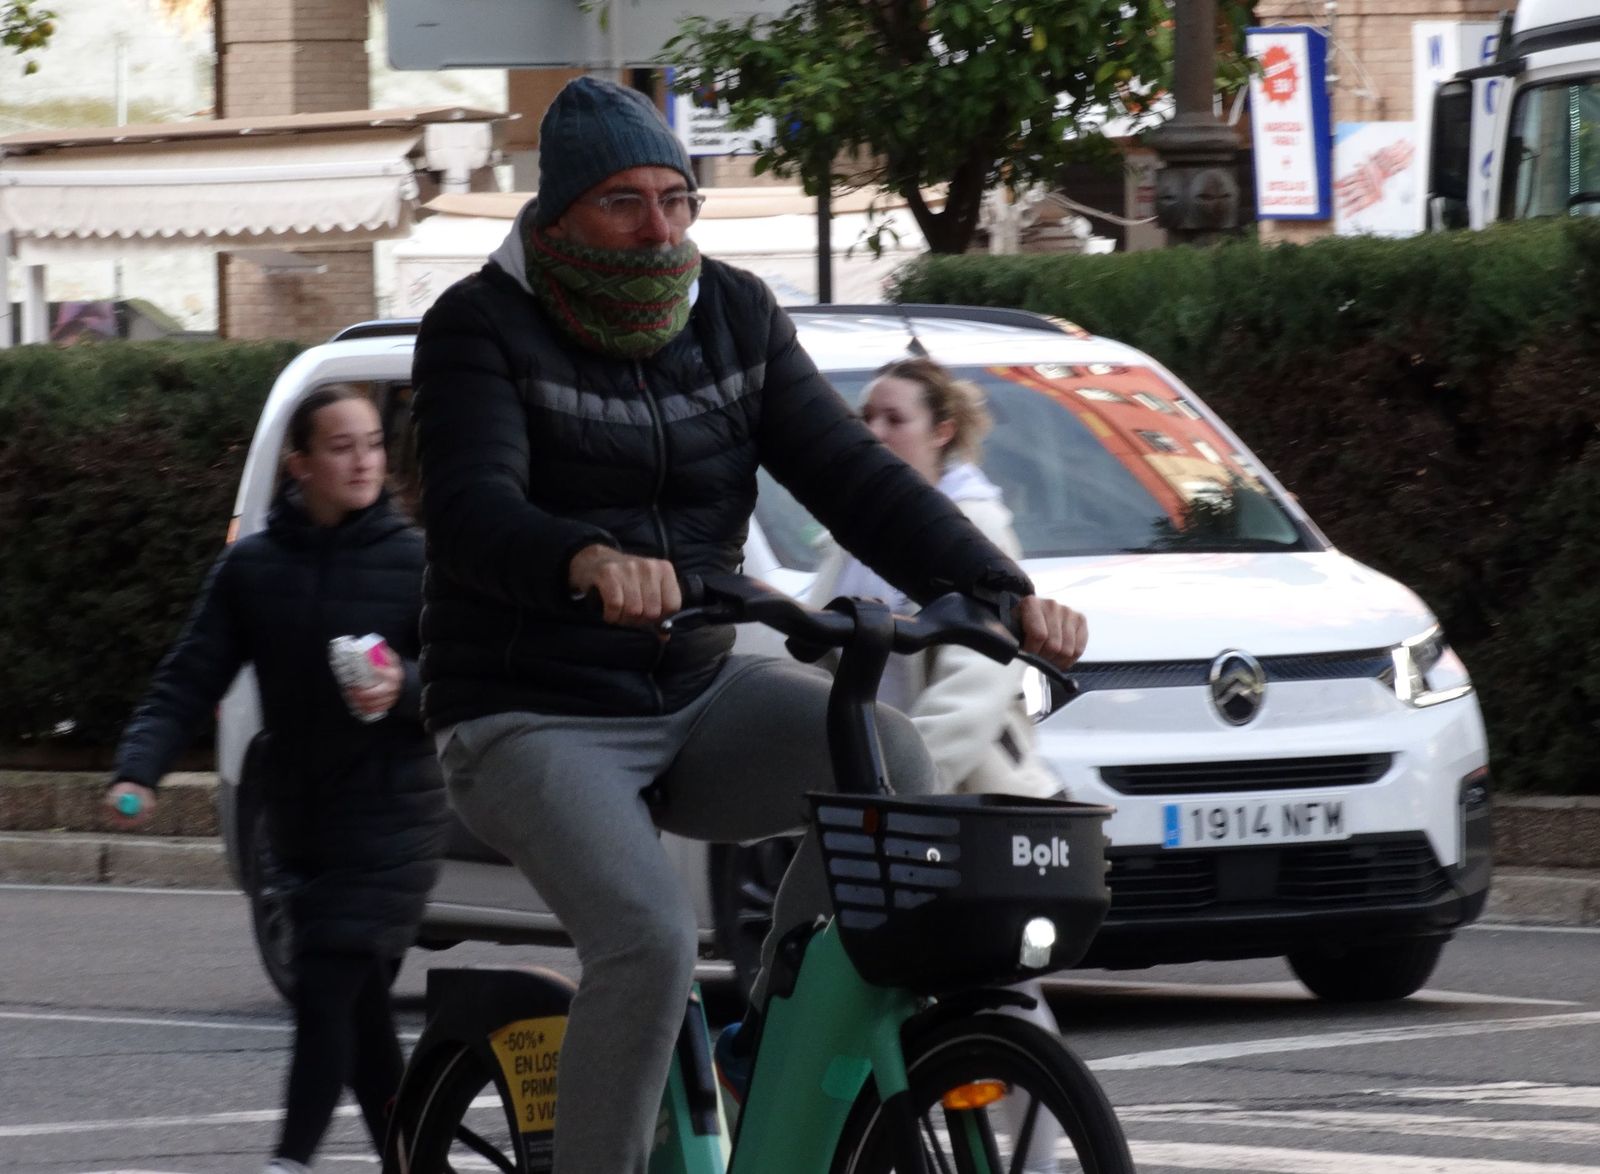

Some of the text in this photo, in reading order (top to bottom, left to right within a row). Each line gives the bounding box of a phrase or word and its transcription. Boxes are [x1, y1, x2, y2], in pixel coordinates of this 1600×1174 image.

[1192, 801, 1344, 841] 1914 NFW
[1012, 835, 1069, 875] Bolt
[515, 1052, 559, 1075] EN LOS
[526, 1103, 534, 1122] 3
